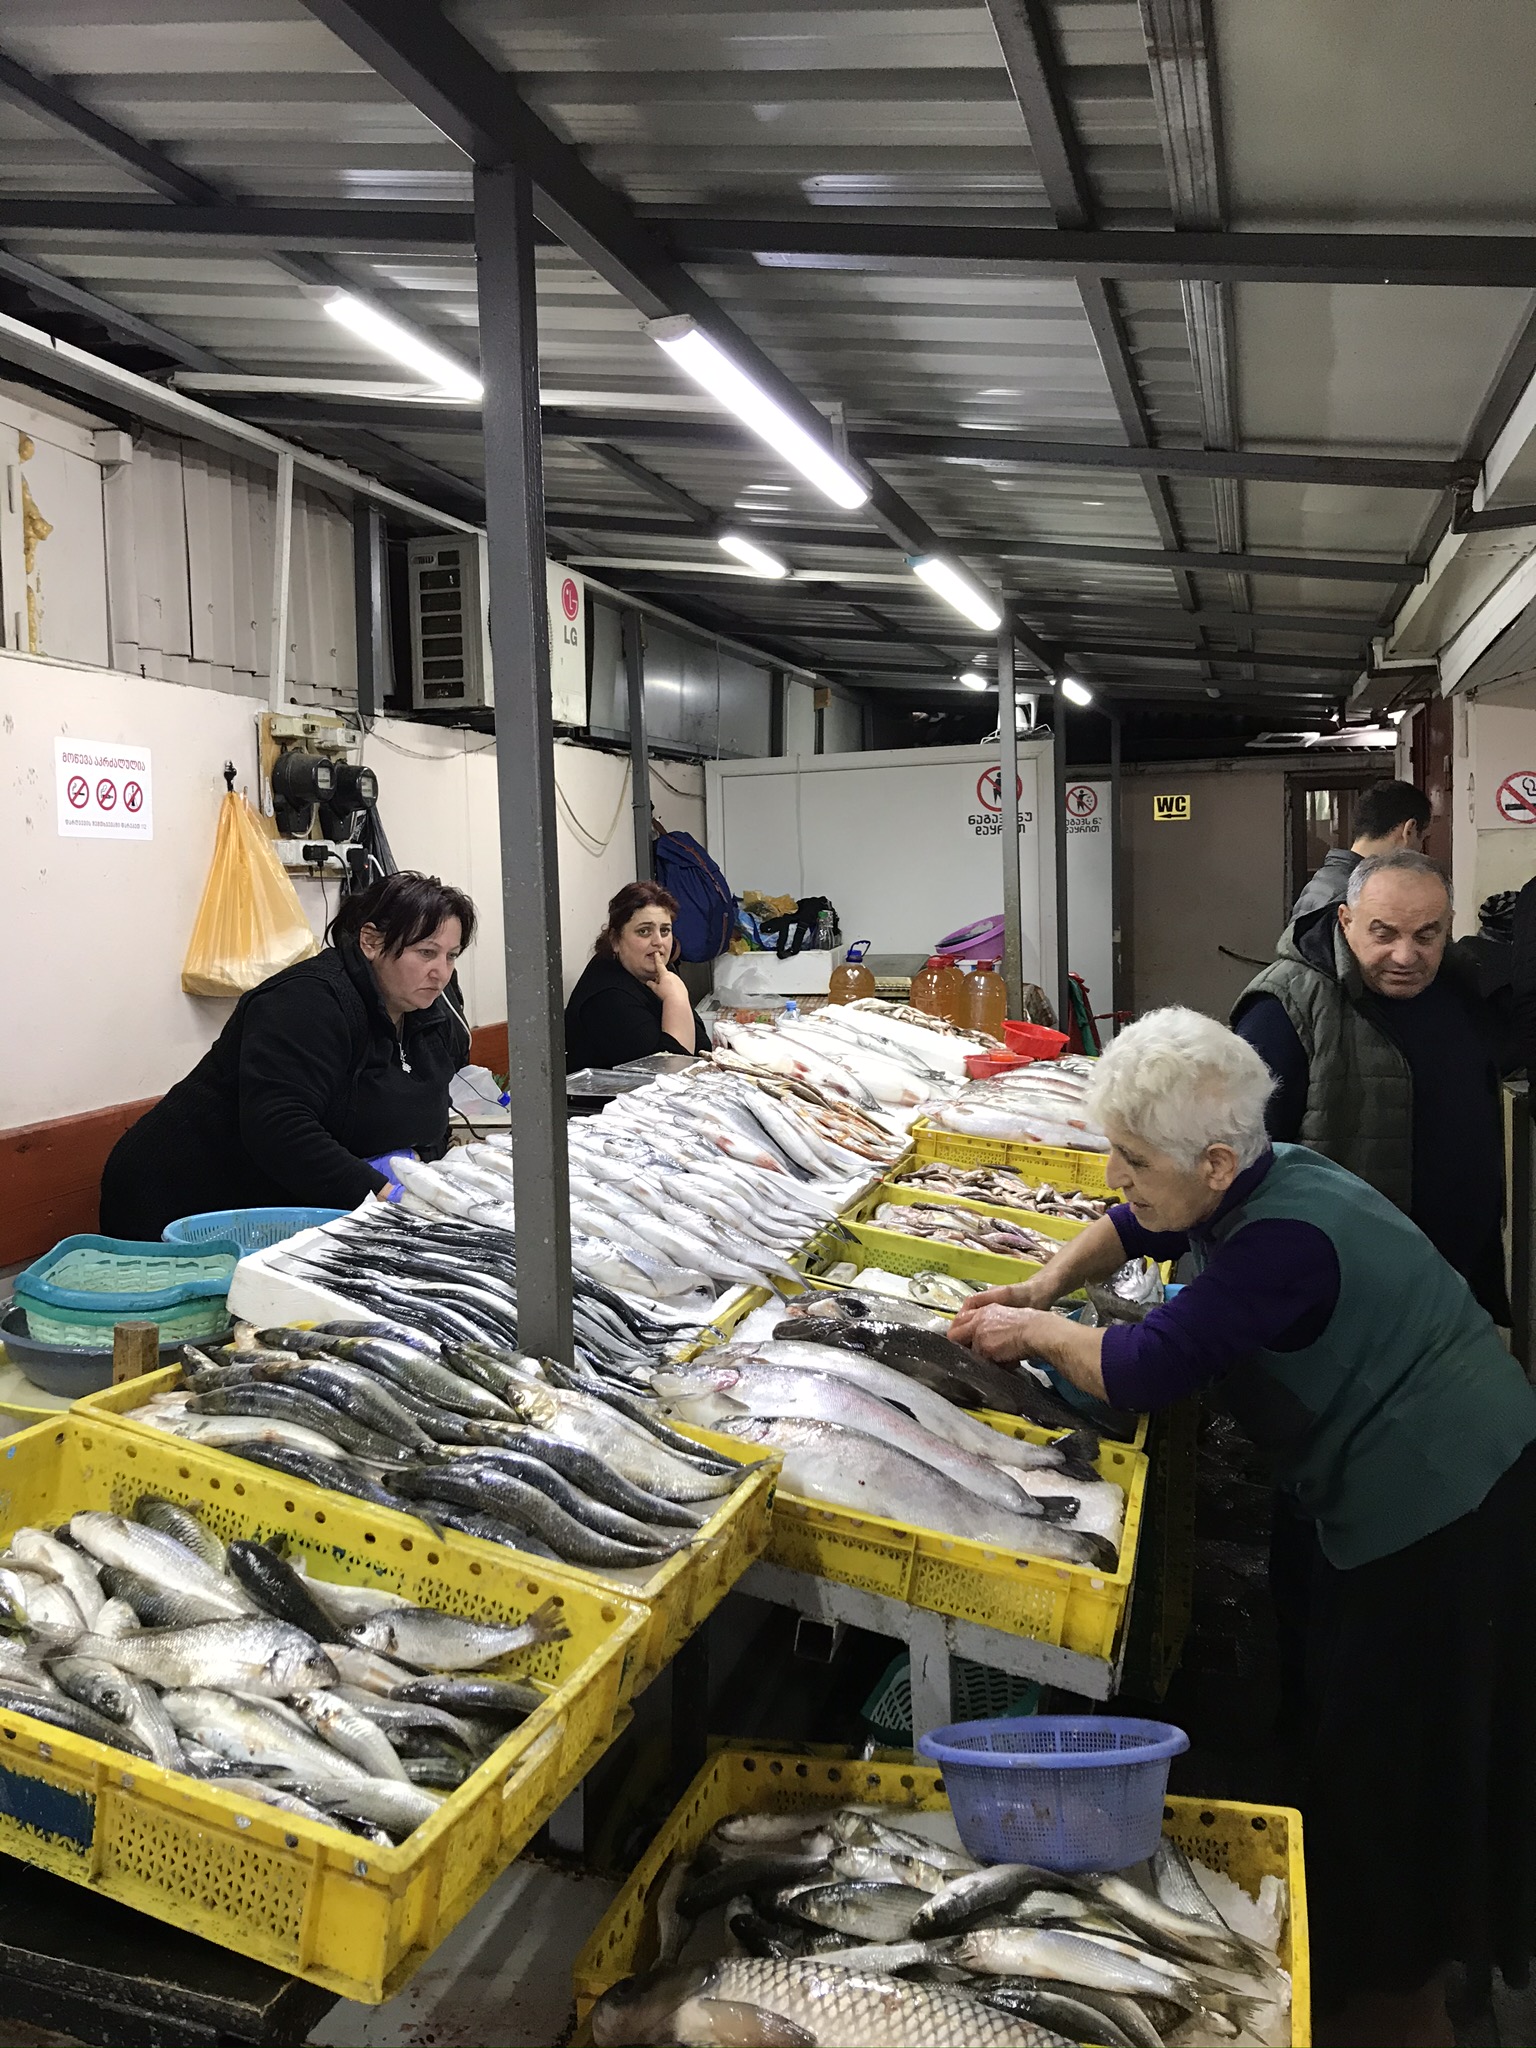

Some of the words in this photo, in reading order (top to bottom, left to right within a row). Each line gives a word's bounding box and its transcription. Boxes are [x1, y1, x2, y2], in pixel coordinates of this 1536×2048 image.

[564, 625, 578, 647] LG
[62, 752, 93, 766] მოწევა
[94, 756, 146, 772] აკრძალულია
[1156, 796, 1187, 813] WC
[968, 814, 1002, 825] ნაგა
